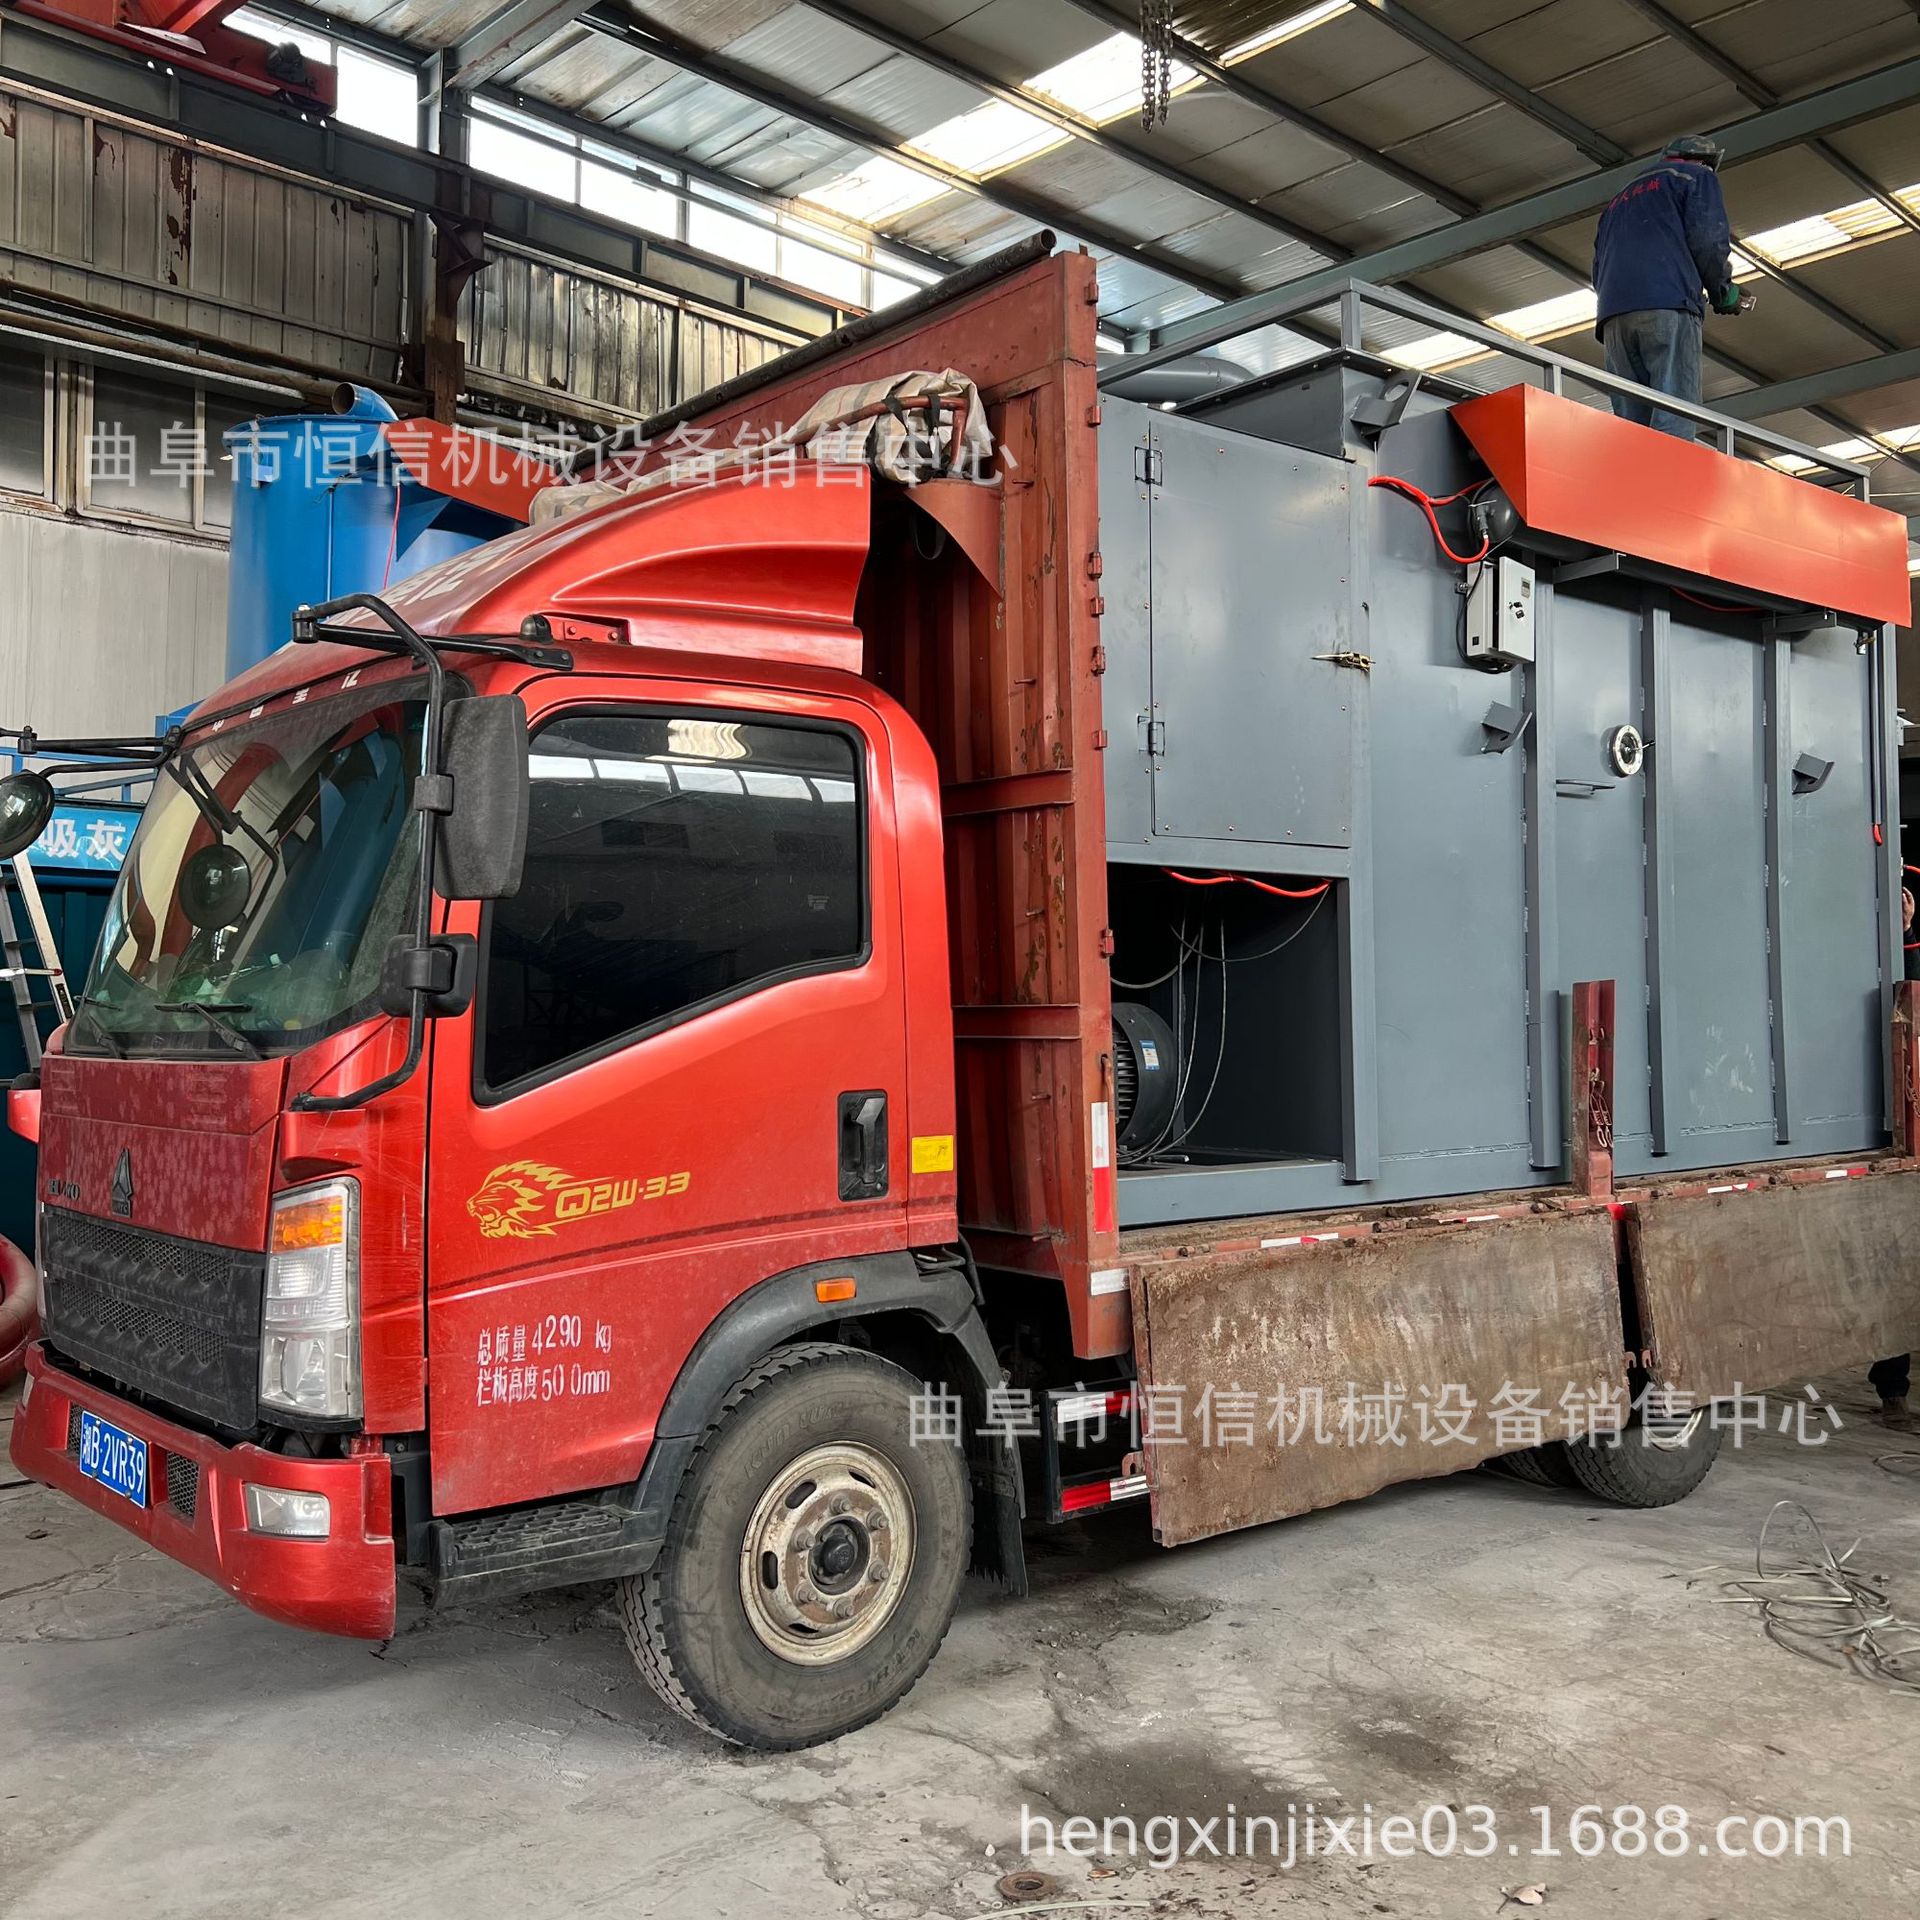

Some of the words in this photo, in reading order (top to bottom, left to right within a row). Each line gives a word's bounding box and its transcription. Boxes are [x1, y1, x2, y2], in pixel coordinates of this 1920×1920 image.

[477, 1324, 526, 1366] 总质量
[531, 1314, 581, 1355] 4290
[595, 1319, 612, 1353] kg
